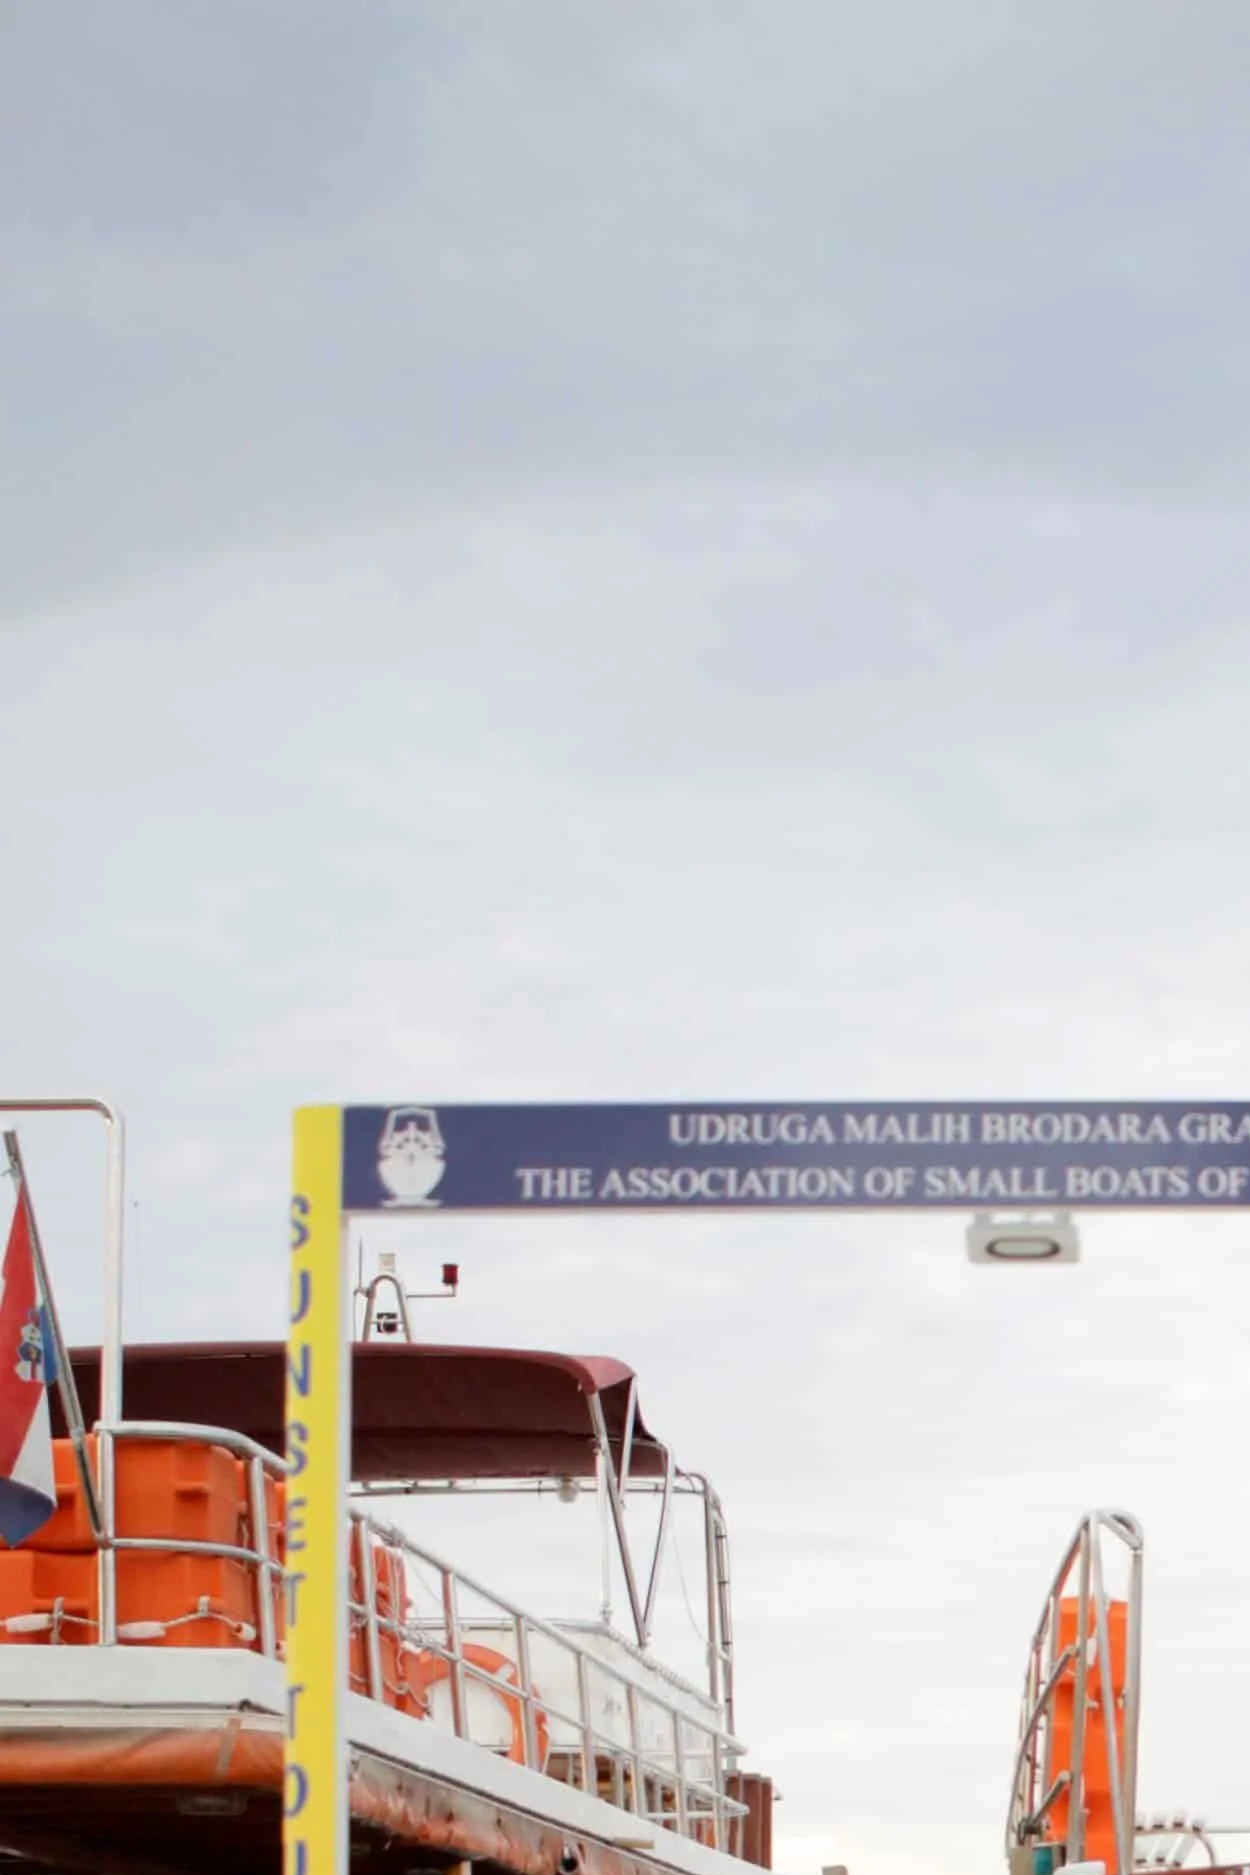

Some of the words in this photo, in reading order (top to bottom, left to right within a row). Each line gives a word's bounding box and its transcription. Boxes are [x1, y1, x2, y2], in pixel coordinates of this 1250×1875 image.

[669, 1113, 833, 1145] UDRUGA
[842, 1113, 974, 1144] MALIH
[981, 1113, 1170, 1144] BRODARA
[517, 1168, 591, 1199] THE
[601, 1168, 857, 1199] ASSOCIATION
[863, 1168, 914, 1199] OF
[923, 1168, 1056, 1198] SMALL
[1065, 1167, 1190, 1198] BOATS
[1197, 1167, 1250, 1198] OF
